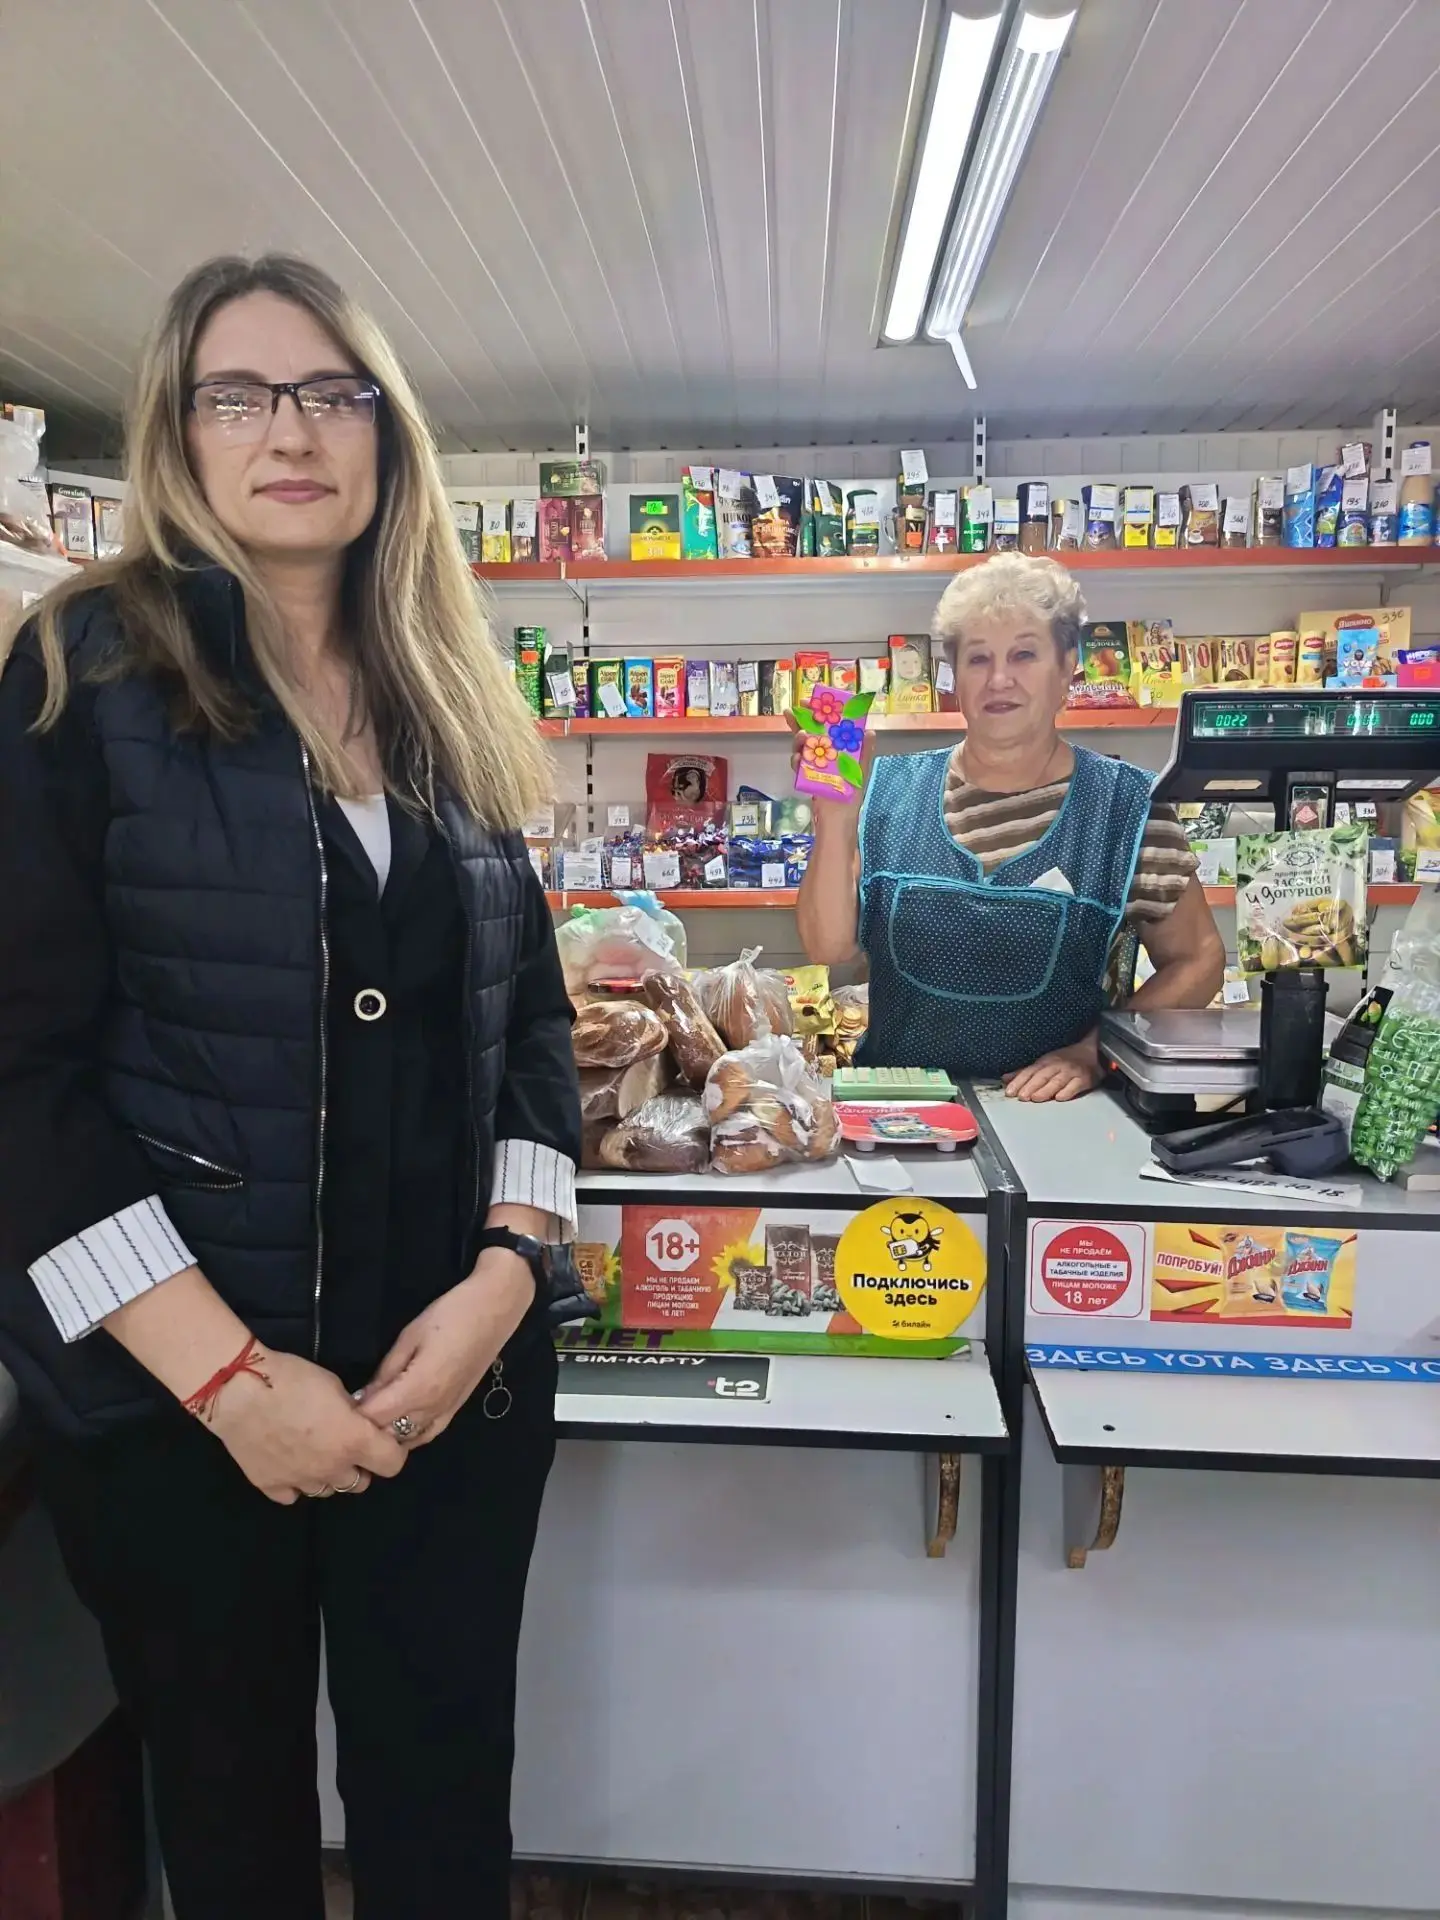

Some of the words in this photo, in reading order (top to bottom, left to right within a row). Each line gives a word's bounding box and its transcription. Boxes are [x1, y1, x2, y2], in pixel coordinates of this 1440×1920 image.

[1274, 886, 1332, 899] ОГУРЦОВ
[651, 1232, 700, 1260] 18+
[1156, 1252, 1222, 1275] ПОПРОБУЙ!
[853, 1273, 969, 1291] Подключись
[1052, 1281, 1080, 1289] ЛИЦАМ
[1082, 1282, 1117, 1290] МОЛОЖЕ
[885, 1293, 938, 1307] здесь
[1064, 1291, 1083, 1304] 18
[1087, 1297, 1108, 1305] лет
[901, 1320, 931, 1329] билайн
[574, 1354, 707, 1366] SIM-КАРТУ
[1027, 1348, 1147, 1367] ЗДЕСЬ
[1152, 1352, 1256, 1371] YOTA
[1267, 1356, 1391, 1375] ЗДЕСЬ
[715, 1376, 760, 1397] t2
